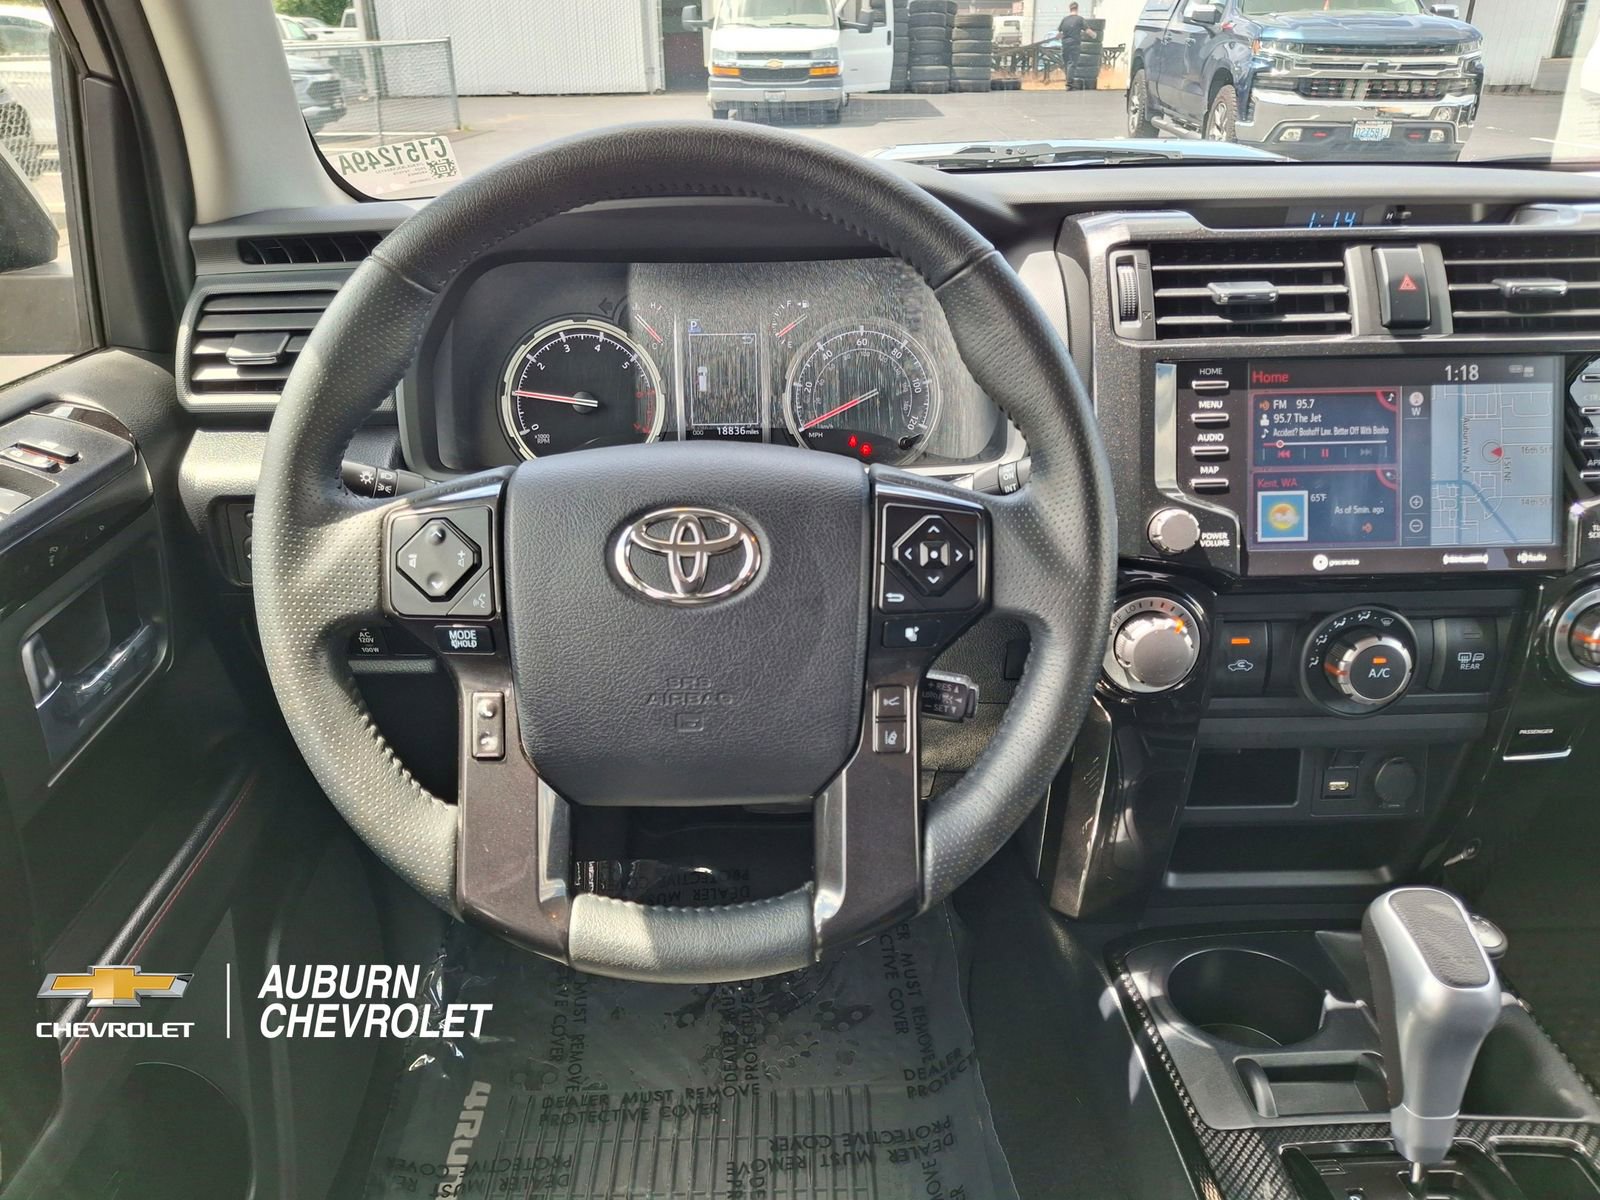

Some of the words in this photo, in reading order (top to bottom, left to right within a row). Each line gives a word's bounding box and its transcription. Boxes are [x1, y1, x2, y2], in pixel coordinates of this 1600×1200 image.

[1308, 212, 1356, 228] 1:14
[856, 338, 867, 346] 60
[563, 344, 571, 353] 3
[594, 344, 601, 353] 4
[891, 348, 903, 360] 80
[822, 350, 833, 361] 40
[536, 362, 545, 371] 2
[622, 362, 630, 370] 5
[1200, 368, 1223, 376] HOME
[1252, 371, 1289, 383] Home
[1444, 364, 1480, 382] 1:18
[804, 381, 813, 394] 20
[911, 377, 922, 394] 100
[1198, 401, 1223, 409] MENU
[1273, 400, 1287, 410] FM
[1295, 399, 1315, 410] 95.7
[1411, 408, 1422, 416] W
[907, 415, 919, 431] 120
[1273, 414, 1292, 424] 95.7
[1294, 413, 1308, 423] The
[1310, 413, 1322, 423] Jet
[531, 423, 539, 432] 0
[717, 426, 746, 436] 18836
[1349, 426, 1360, 436] Off
[1462, 417, 1471, 445] Auburn
[1197, 434, 1224, 442] AUDIO
[1462, 446, 1471, 464] Way
[1521, 446, 1538, 455] 16th
[1200, 466, 1220, 474] MAP
[1462, 465, 1470, 473] N
[1503, 471, 1511, 482] NE
[1004, 483, 1017, 493] INT
[1281, 478, 1297, 487] WA
[1334, 506, 1343, 514] As
[1344, 506, 1354, 514] of
[1372, 507, 1385, 515] ago
[1201, 532, 1228, 541] POWER
[1200, 539, 1230, 548] VOLUME
[1125, 604, 1136, 615] LO
[448, 629, 477, 640] MODE
[457, 640, 477, 648] HOLD
[1368, 667, 1391, 679] A/C
[934, 704, 949, 713] SET
[573, 981, 588, 1025] MUST
[900, 952, 922, 998] MUST
[911, 1005, 935, 1063] REMOVE
[888, 987, 909, 1036] COVER
[550, 1014, 567, 1063] COVER
[565, 1034, 585, 1094] REMOVE
[904, 1048, 962, 1081] DEALER
[541, 1093, 610, 1109] DEALER
[623, 1089, 674, 1104] MUST
[686, 1083, 760, 1100] REMOVE
[540, 1108, 649, 1127] PROTECTIVE
[659, 1102, 719, 1120] COVER
[842, 1114, 951, 1147] PROTECTIVE
[770, 1134, 833, 1152] COVER
[887, 1132, 955, 1164] DEALER
[464, 1153, 572, 1173] PROTECTIVE
[820, 1150, 873, 1168] MUST
[387, 1155, 458, 1178] COVER
[499, 1173, 570, 1191] DEALER
[435, 1178, 487, 1199] MUST
